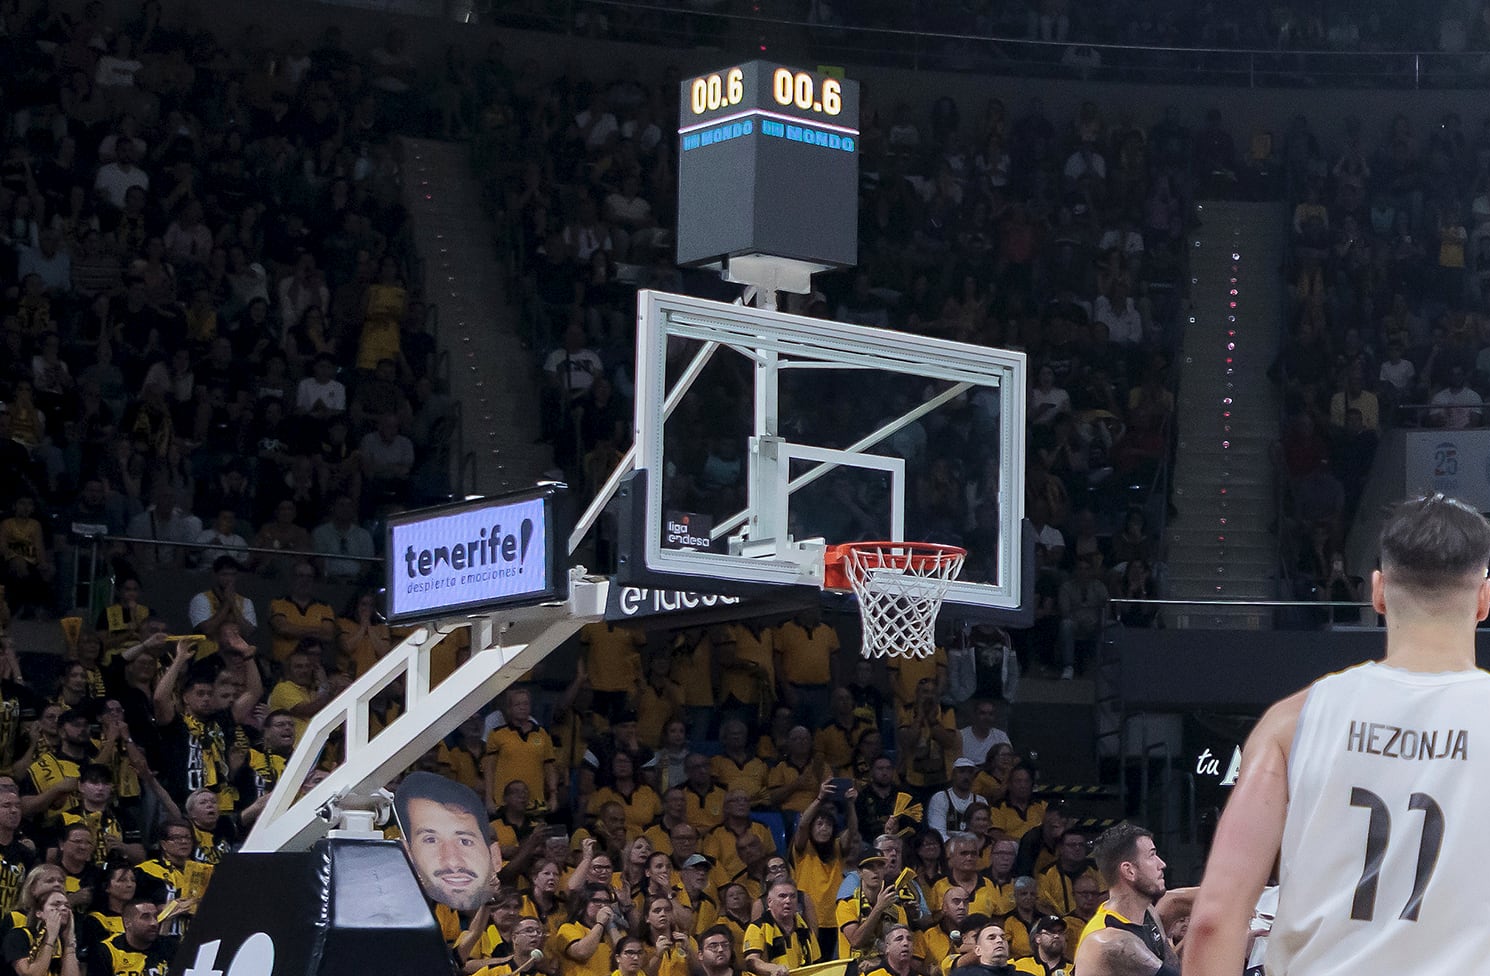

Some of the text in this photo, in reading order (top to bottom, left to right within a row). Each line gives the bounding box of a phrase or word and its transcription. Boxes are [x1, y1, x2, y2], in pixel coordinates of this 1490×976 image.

[690, 66, 744, 115] 00.6
[773, 67, 842, 116] 00.6
[668, 521, 688, 534] liga
[668, 533, 710, 547] endesa
[407, 567, 516, 594] despierta emociones
[1347, 720, 1468, 761] HEZONJA
